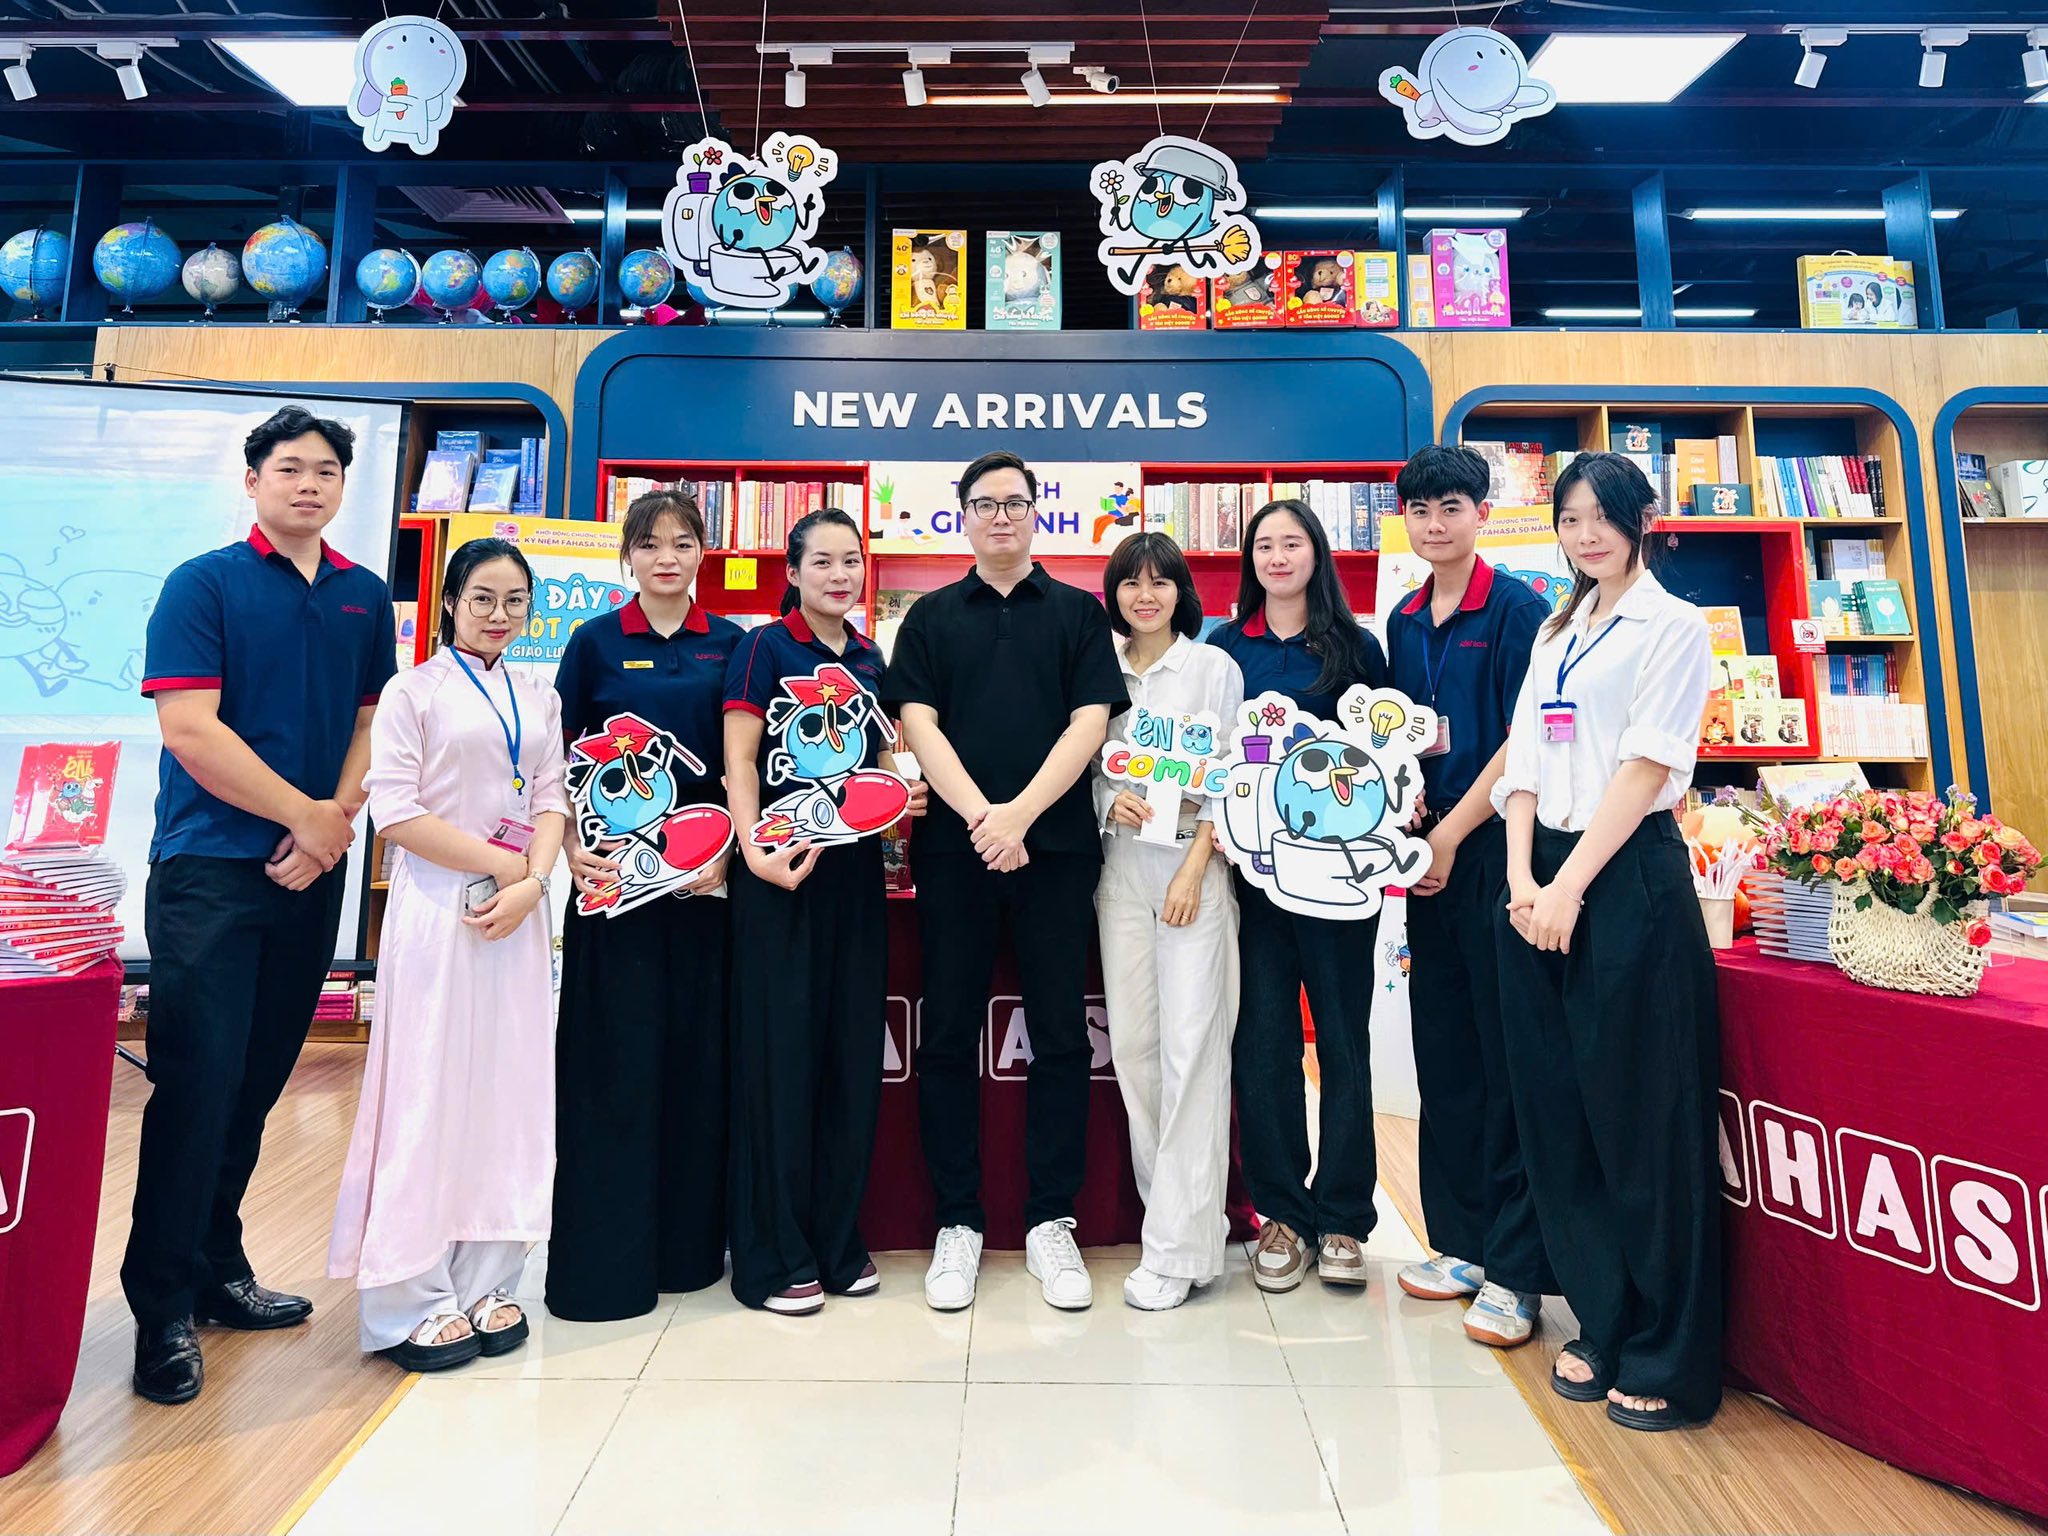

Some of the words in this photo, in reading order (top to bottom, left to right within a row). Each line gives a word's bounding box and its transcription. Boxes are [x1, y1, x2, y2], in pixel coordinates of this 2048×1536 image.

[793, 391, 918, 428] NEW
[931, 391, 1208, 429] ARRIVALS
[931, 510, 963, 534] GI
[1034, 511, 1079, 534] NH
[1482, 527, 1517, 536] FAHASA
[561, 540, 595, 548] FAHASA
[729, 568, 753, 581] 10%
[546, 578, 606, 610] ĐÂY
[520, 610, 562, 644] ỘT
